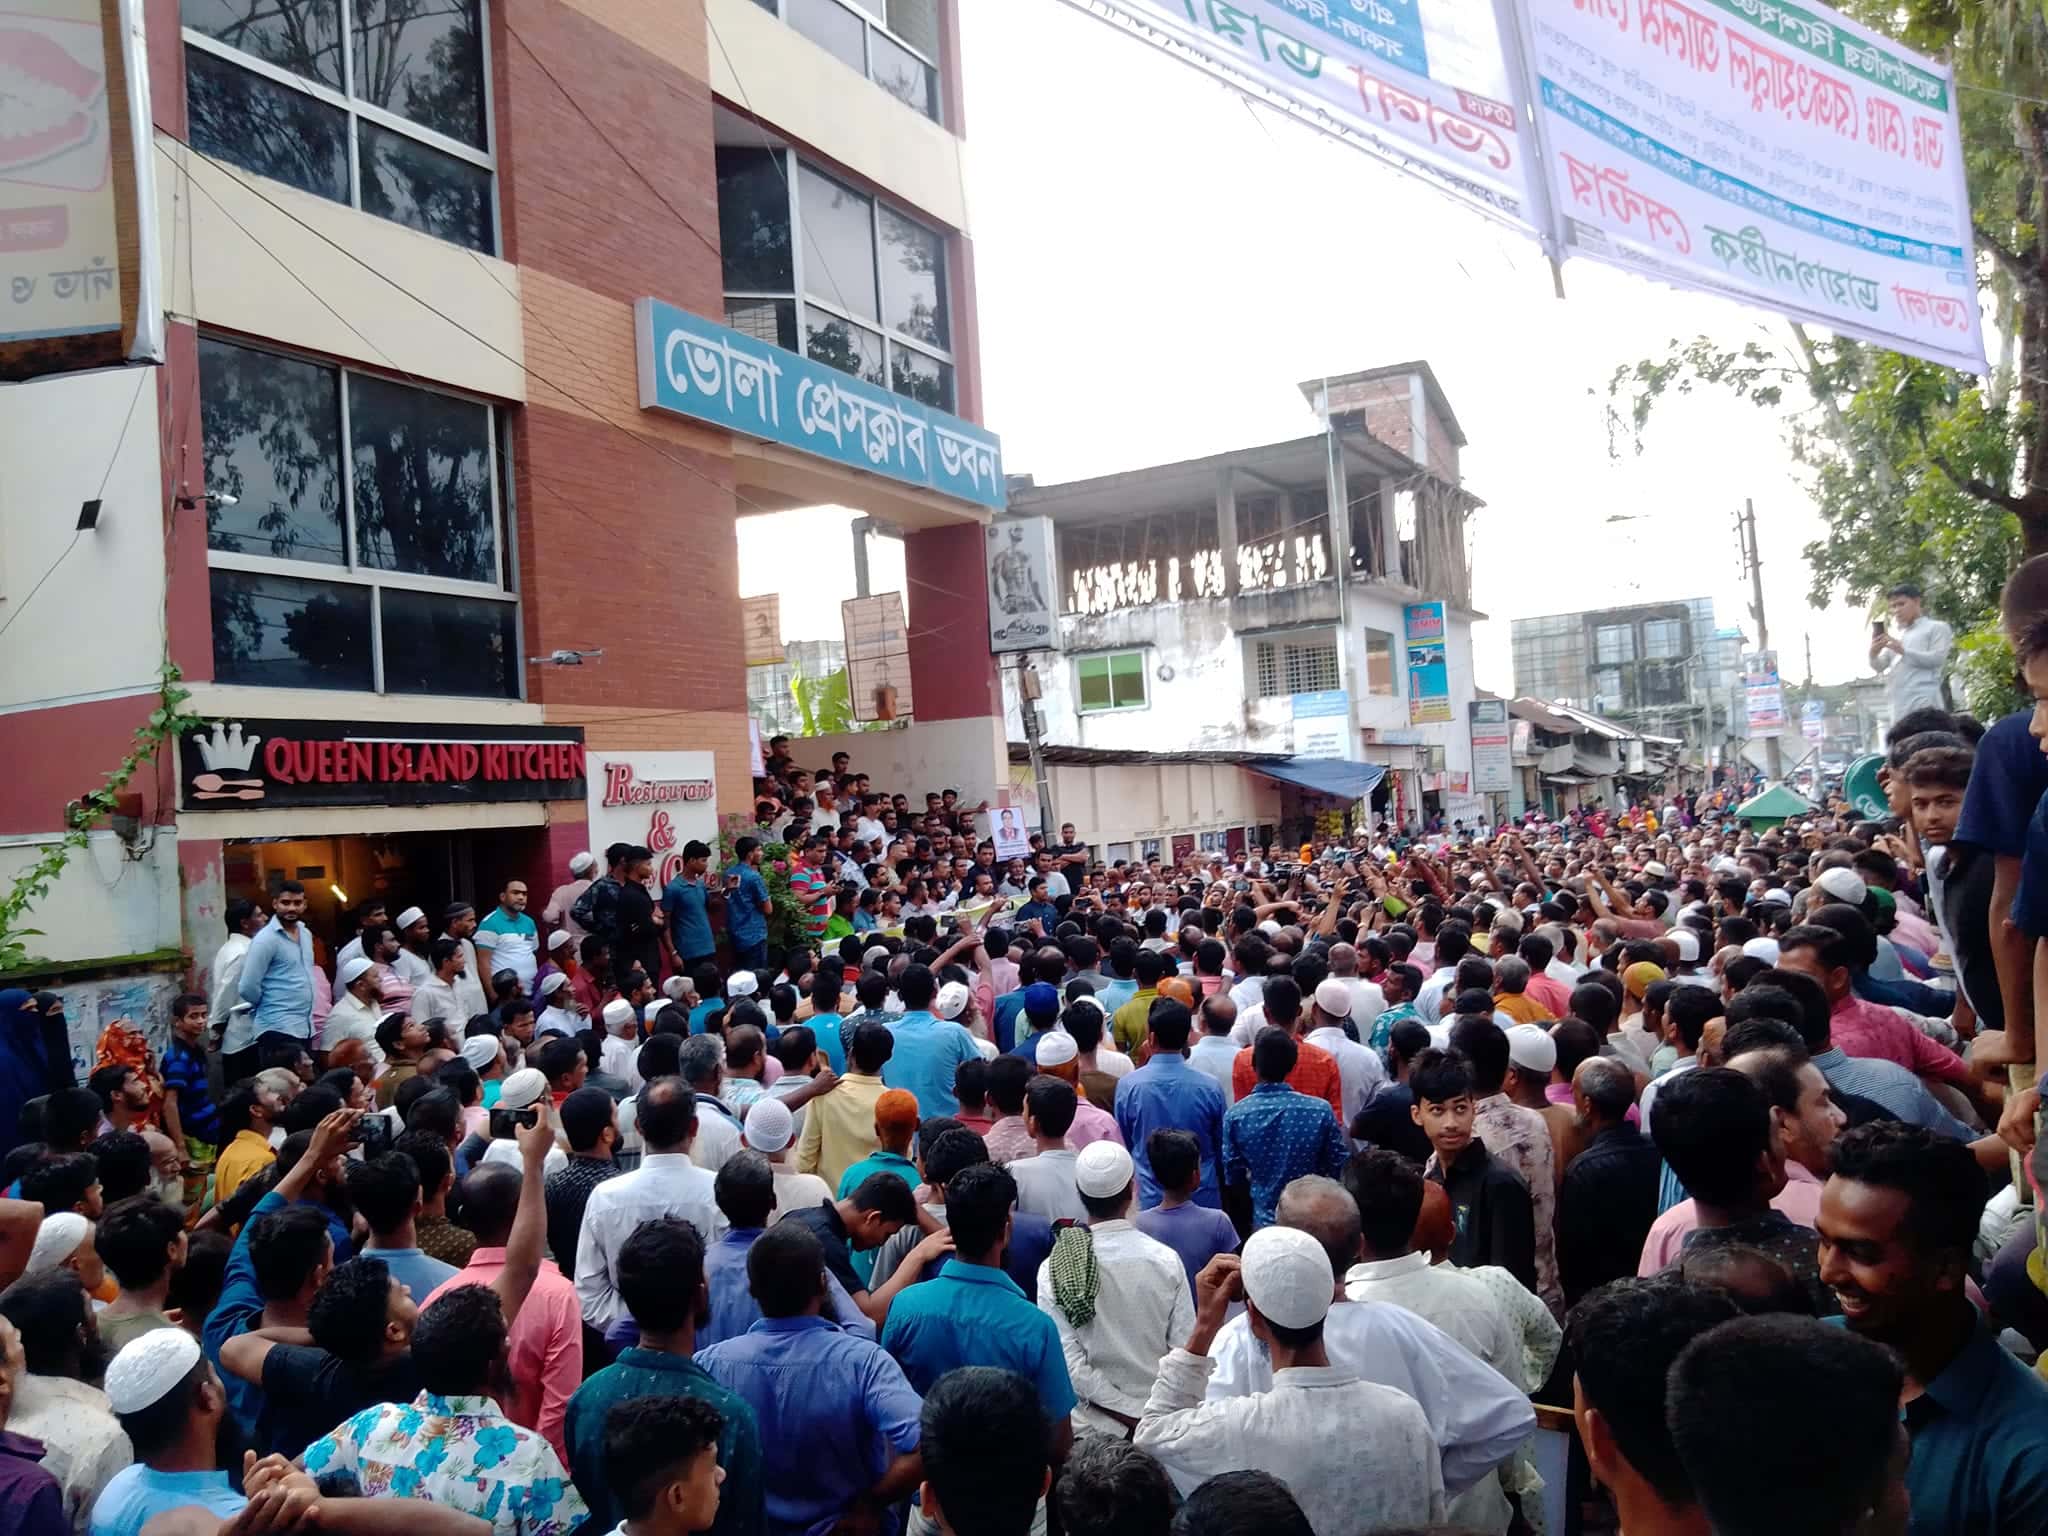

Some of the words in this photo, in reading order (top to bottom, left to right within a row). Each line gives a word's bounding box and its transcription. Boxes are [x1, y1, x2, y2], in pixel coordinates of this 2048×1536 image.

[664, 327, 784, 428] ভোলা
[796, 376, 929, 476] প্রেসক্লাব
[932, 423, 1002, 498] ভবন
[264, 737, 373, 785] QUEEN
[376, 740, 480, 784] ISLAND
[482, 742, 587, 782] KITCHEN
[602, 760, 715, 808] Restaurant
[647, 809, 678, 854] &
